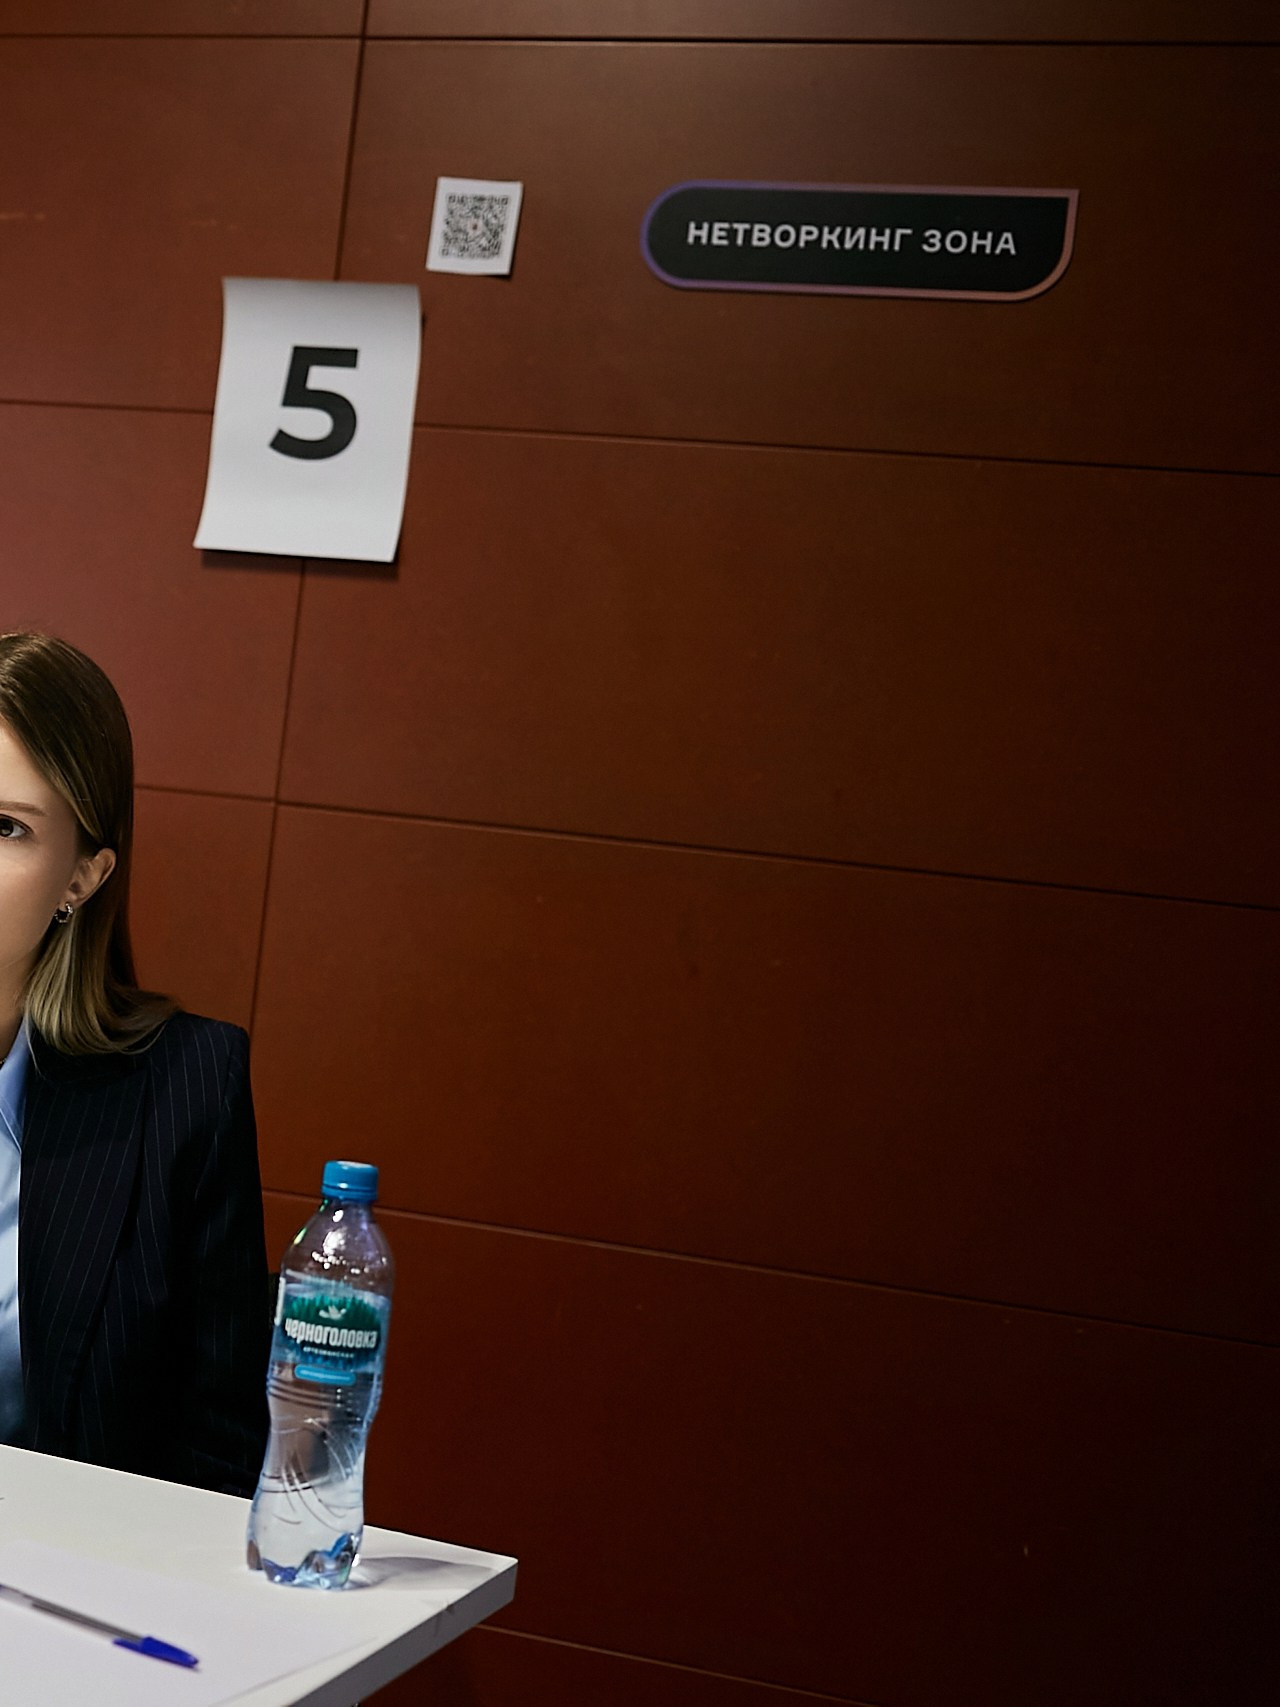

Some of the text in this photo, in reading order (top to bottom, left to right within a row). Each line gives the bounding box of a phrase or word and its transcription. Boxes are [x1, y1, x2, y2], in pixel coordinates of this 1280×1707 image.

[687, 220, 1017, 255] НЕТВОРКИНГ ЗОНА
[269, 346, 358, 460] 5
[284, 1317, 378, 1349] черноголовка
